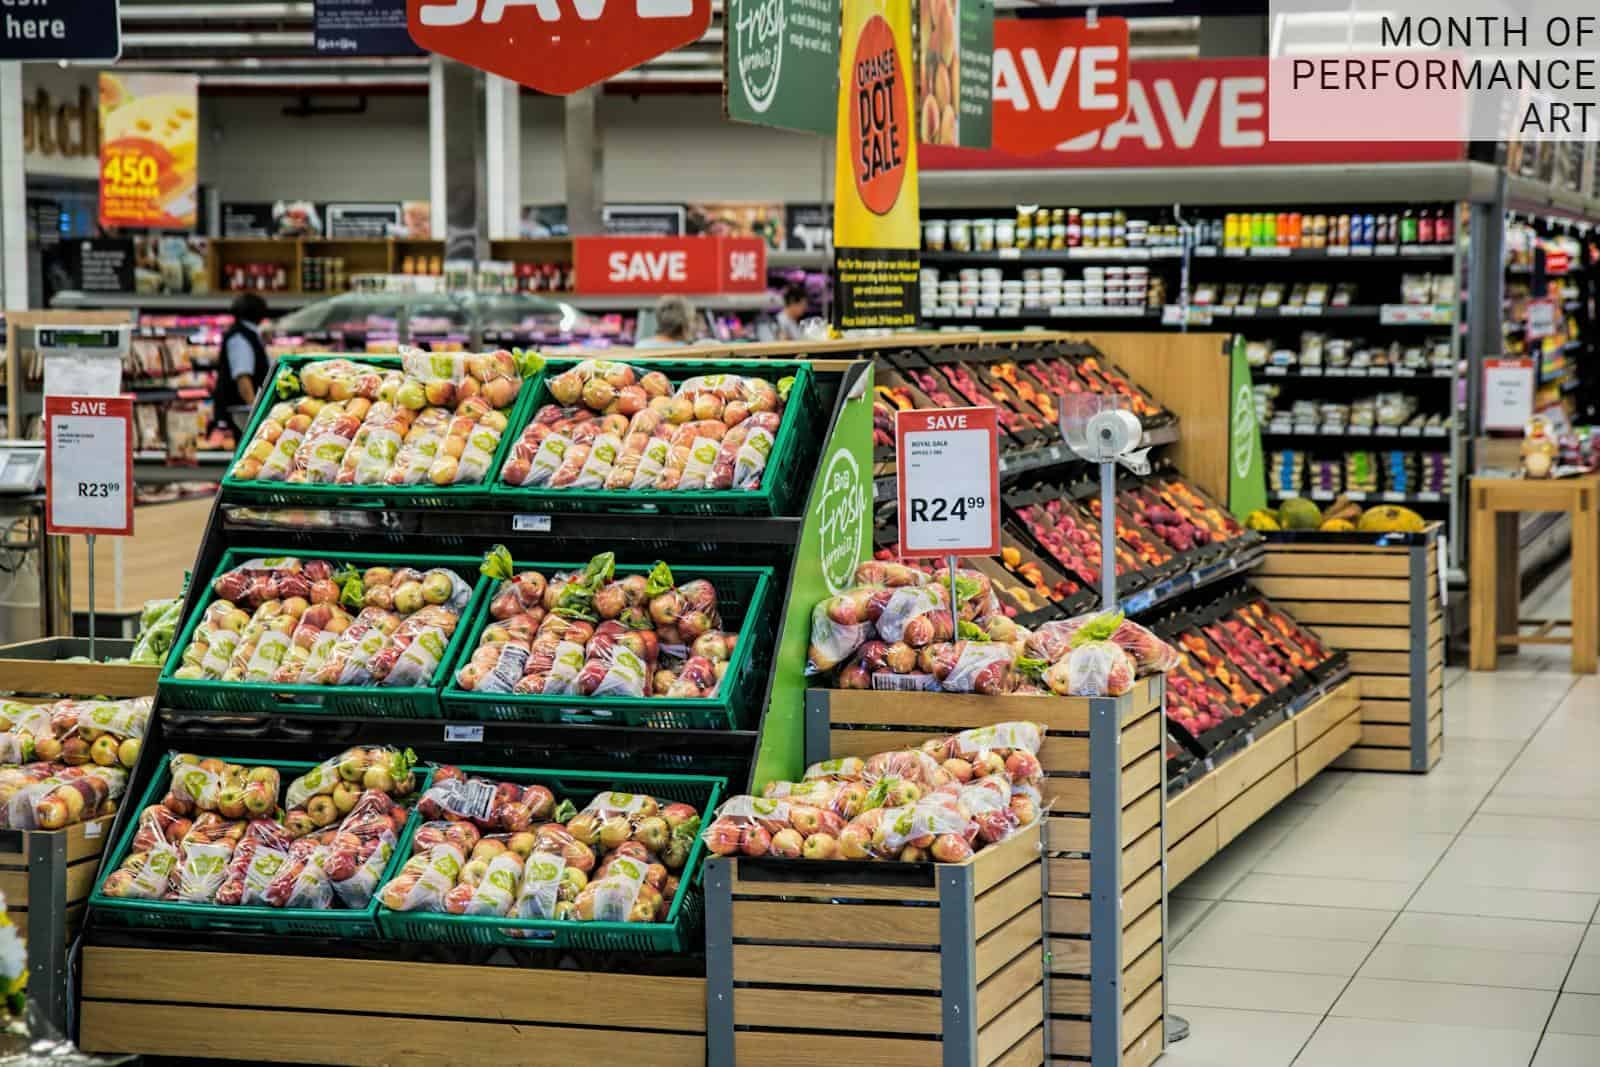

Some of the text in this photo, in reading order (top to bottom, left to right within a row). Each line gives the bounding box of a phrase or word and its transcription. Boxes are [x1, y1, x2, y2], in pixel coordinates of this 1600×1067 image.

[6, 14, 66, 39] here
[857, 48, 895, 87] ORANGE
[992, 46, 1118, 111] AVE
[859, 76, 896, 138] DOT
[1055, 77, 1266, 151] AVE
[103, 154, 159, 186] 450
[861, 123, 901, 182] SALE
[609, 251, 687, 281] SAVE
[71, 401, 107, 416] SAVE
[926, 415, 968, 430] SAVE
